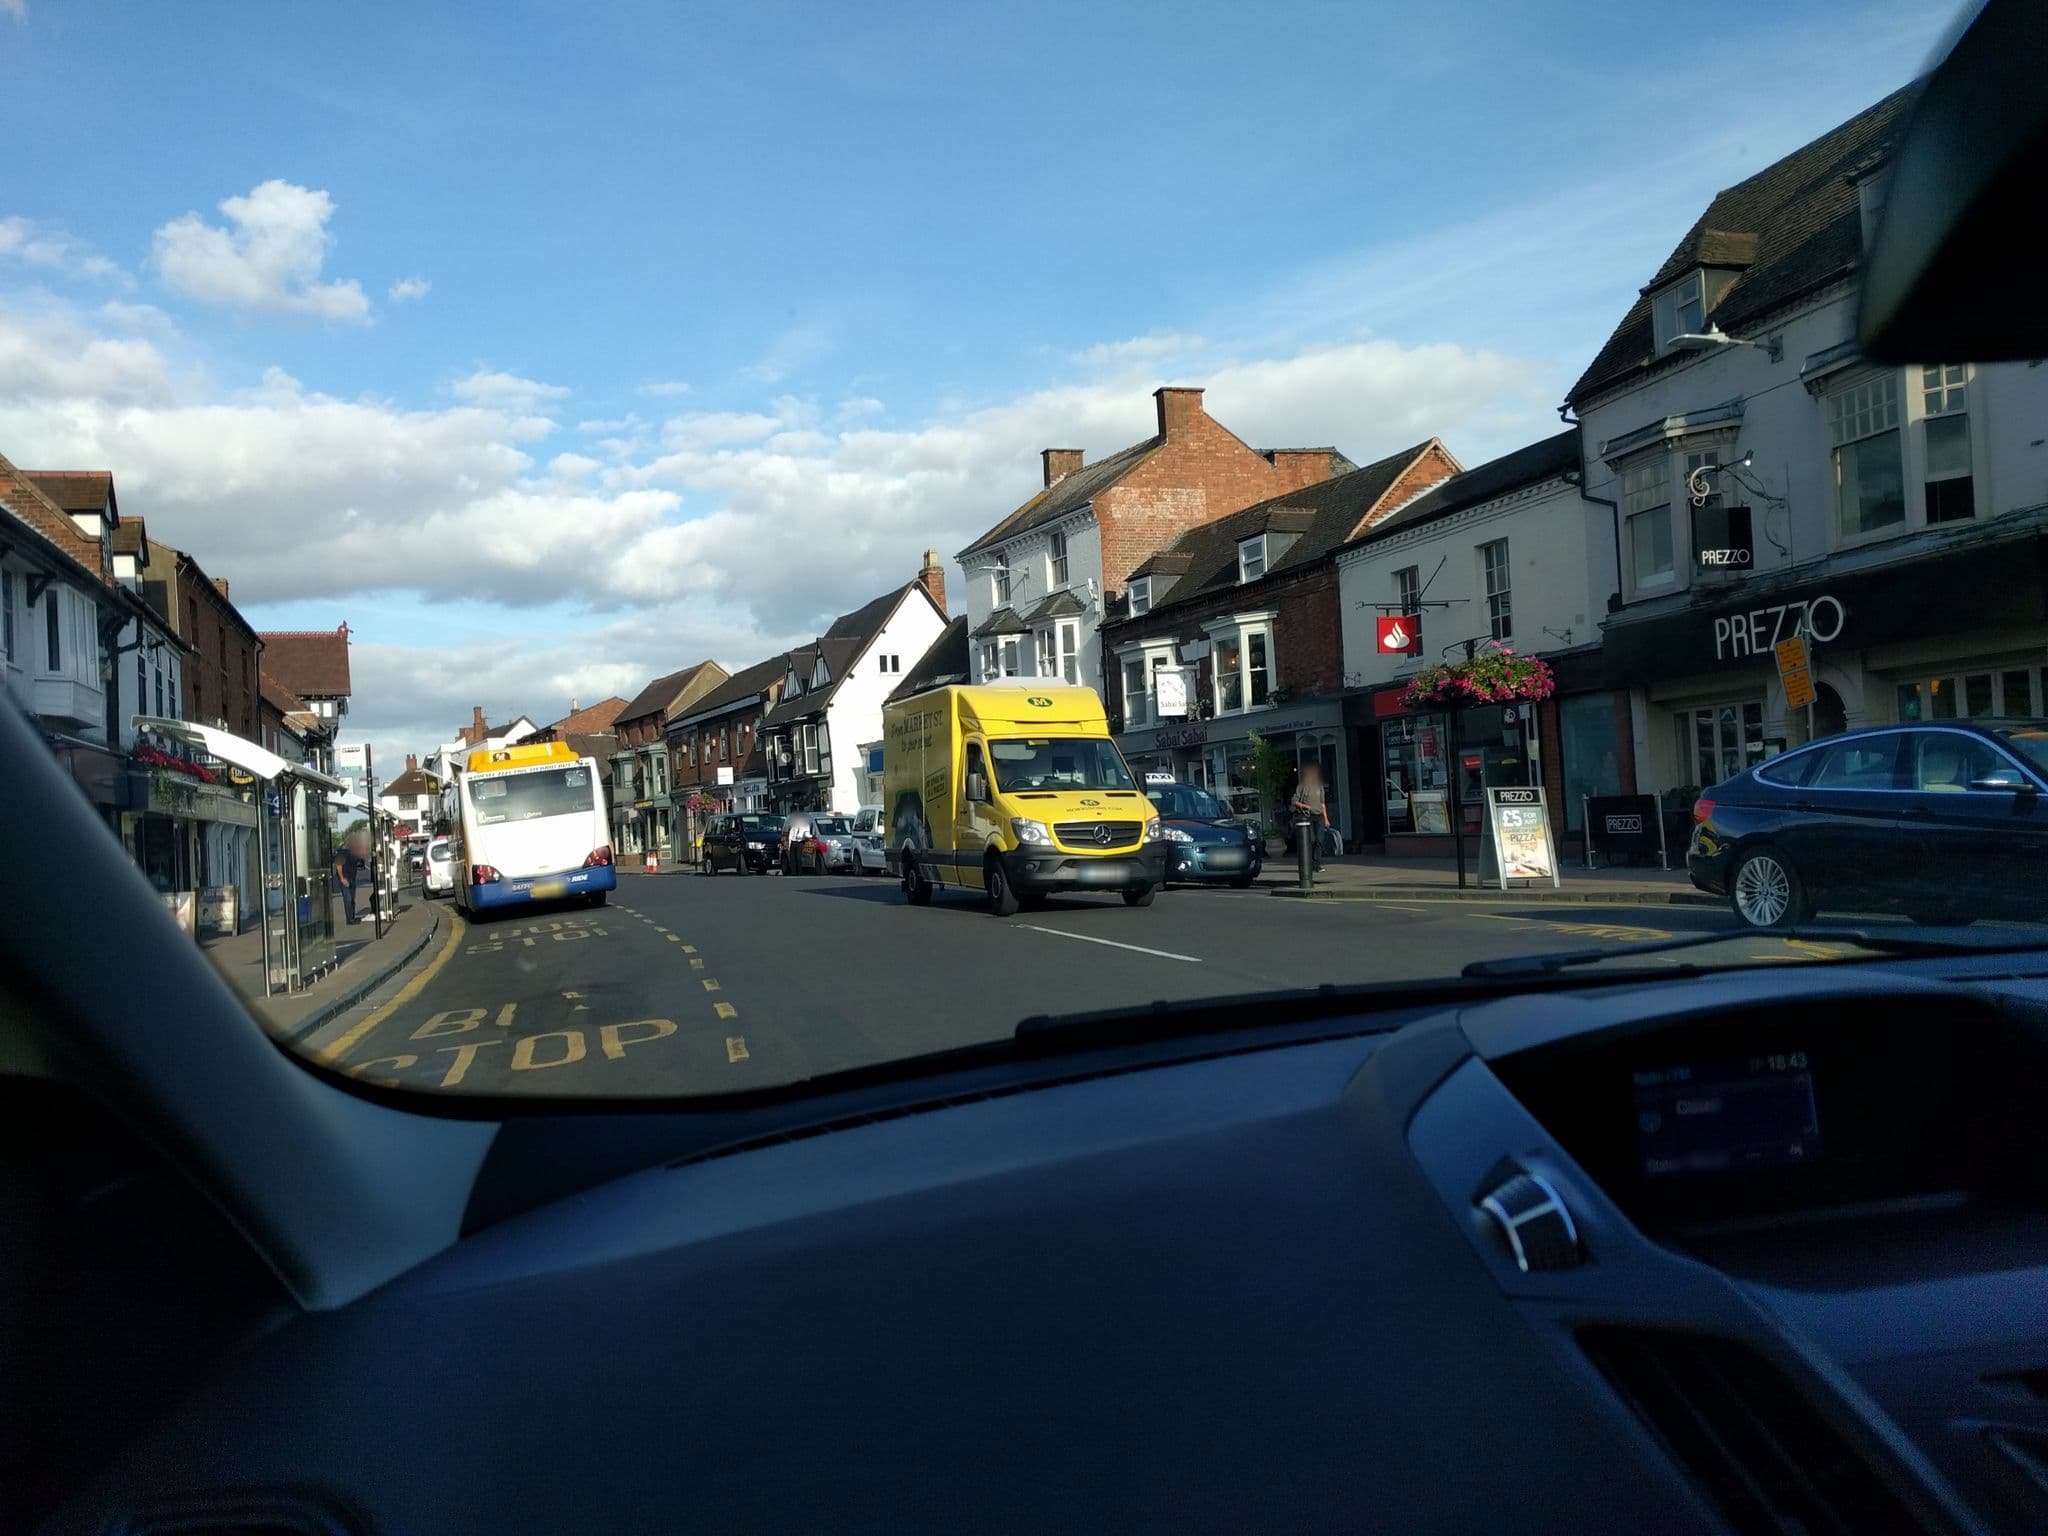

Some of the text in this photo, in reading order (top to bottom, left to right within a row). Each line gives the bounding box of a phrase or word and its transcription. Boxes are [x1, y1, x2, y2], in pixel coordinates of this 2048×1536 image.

[1702, 548, 1750, 566] PREZZO
[1714, 595, 1845, 660] PREZZO
[1155, 727, 1207, 750] Sabai Sabai
[1501, 791, 1533, 801] PREZZO
[1502, 810, 1522, 827] £5
[1608, 818, 1640, 830] PREZZO
[1510, 834, 1536, 842] PIZZA
